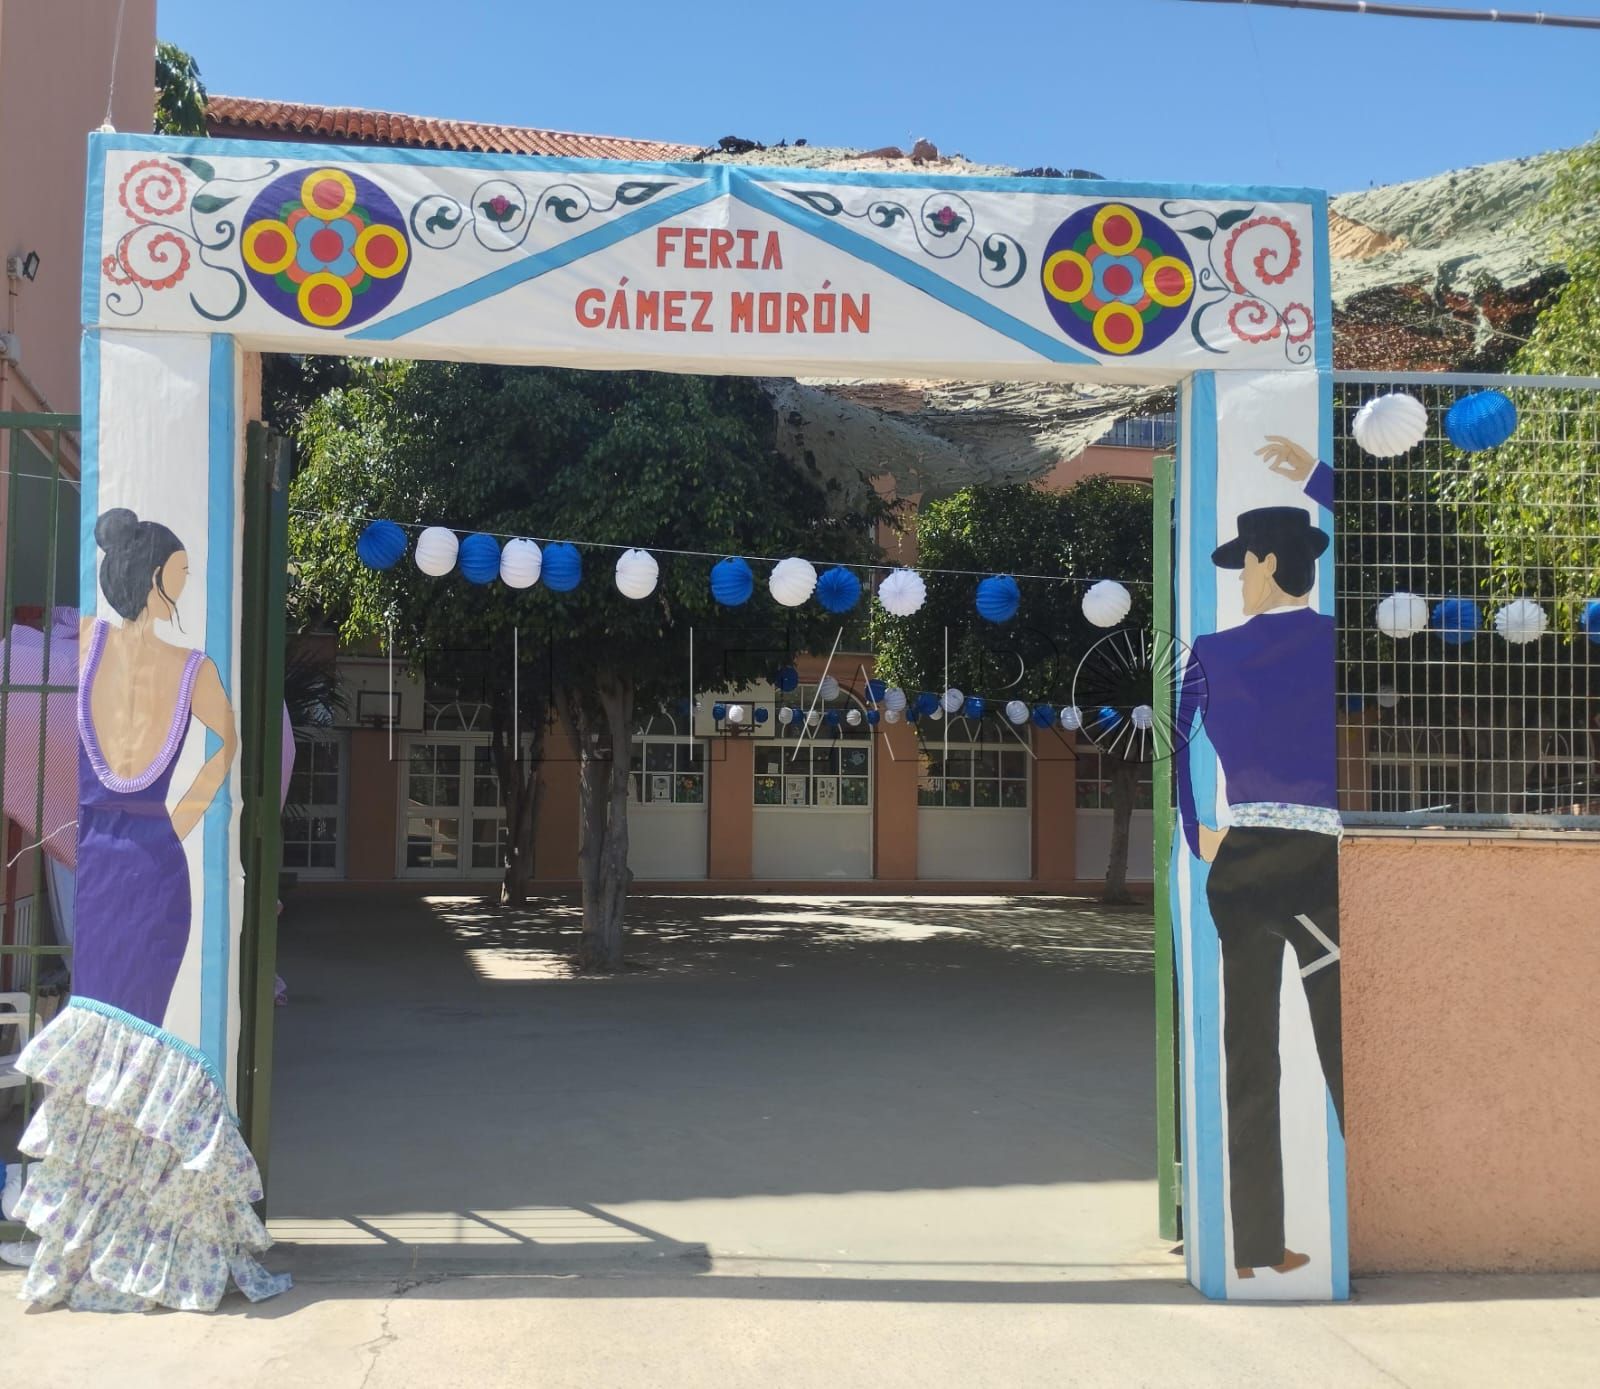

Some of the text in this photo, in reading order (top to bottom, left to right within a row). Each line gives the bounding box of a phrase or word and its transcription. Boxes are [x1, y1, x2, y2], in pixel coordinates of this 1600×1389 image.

[656, 226, 783, 270] FERIA
[575, 276, 871, 334] GÁMEZ MORÓN
